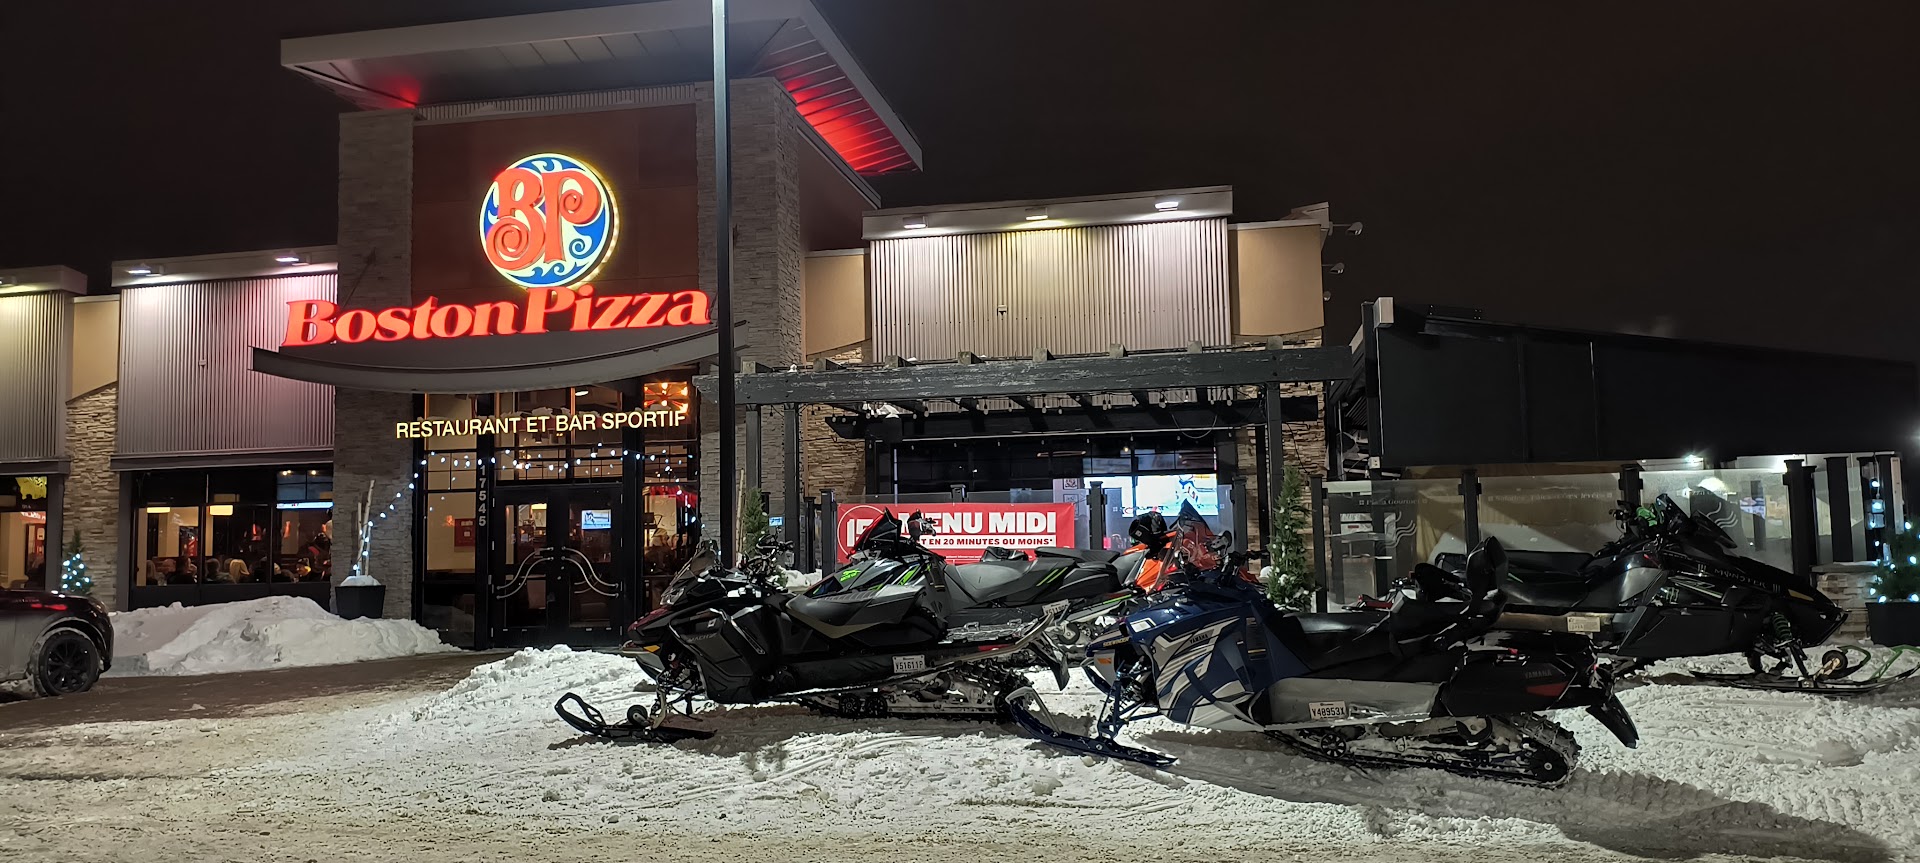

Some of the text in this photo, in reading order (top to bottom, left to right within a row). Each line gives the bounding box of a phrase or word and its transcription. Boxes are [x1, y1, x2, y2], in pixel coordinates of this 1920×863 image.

[486, 167, 601, 271] BP
[282, 284, 711, 347] Boston Pizza
[396, 410, 686, 438] RESTAURANT ET BAR SPORTIF
[477, 465, 487, 527] 17545
[988, 512, 1057, 533] MIDI
[1190, 633, 1209, 645] YAMAHA
[1525, 669, 1552, 679] YAMAHA
